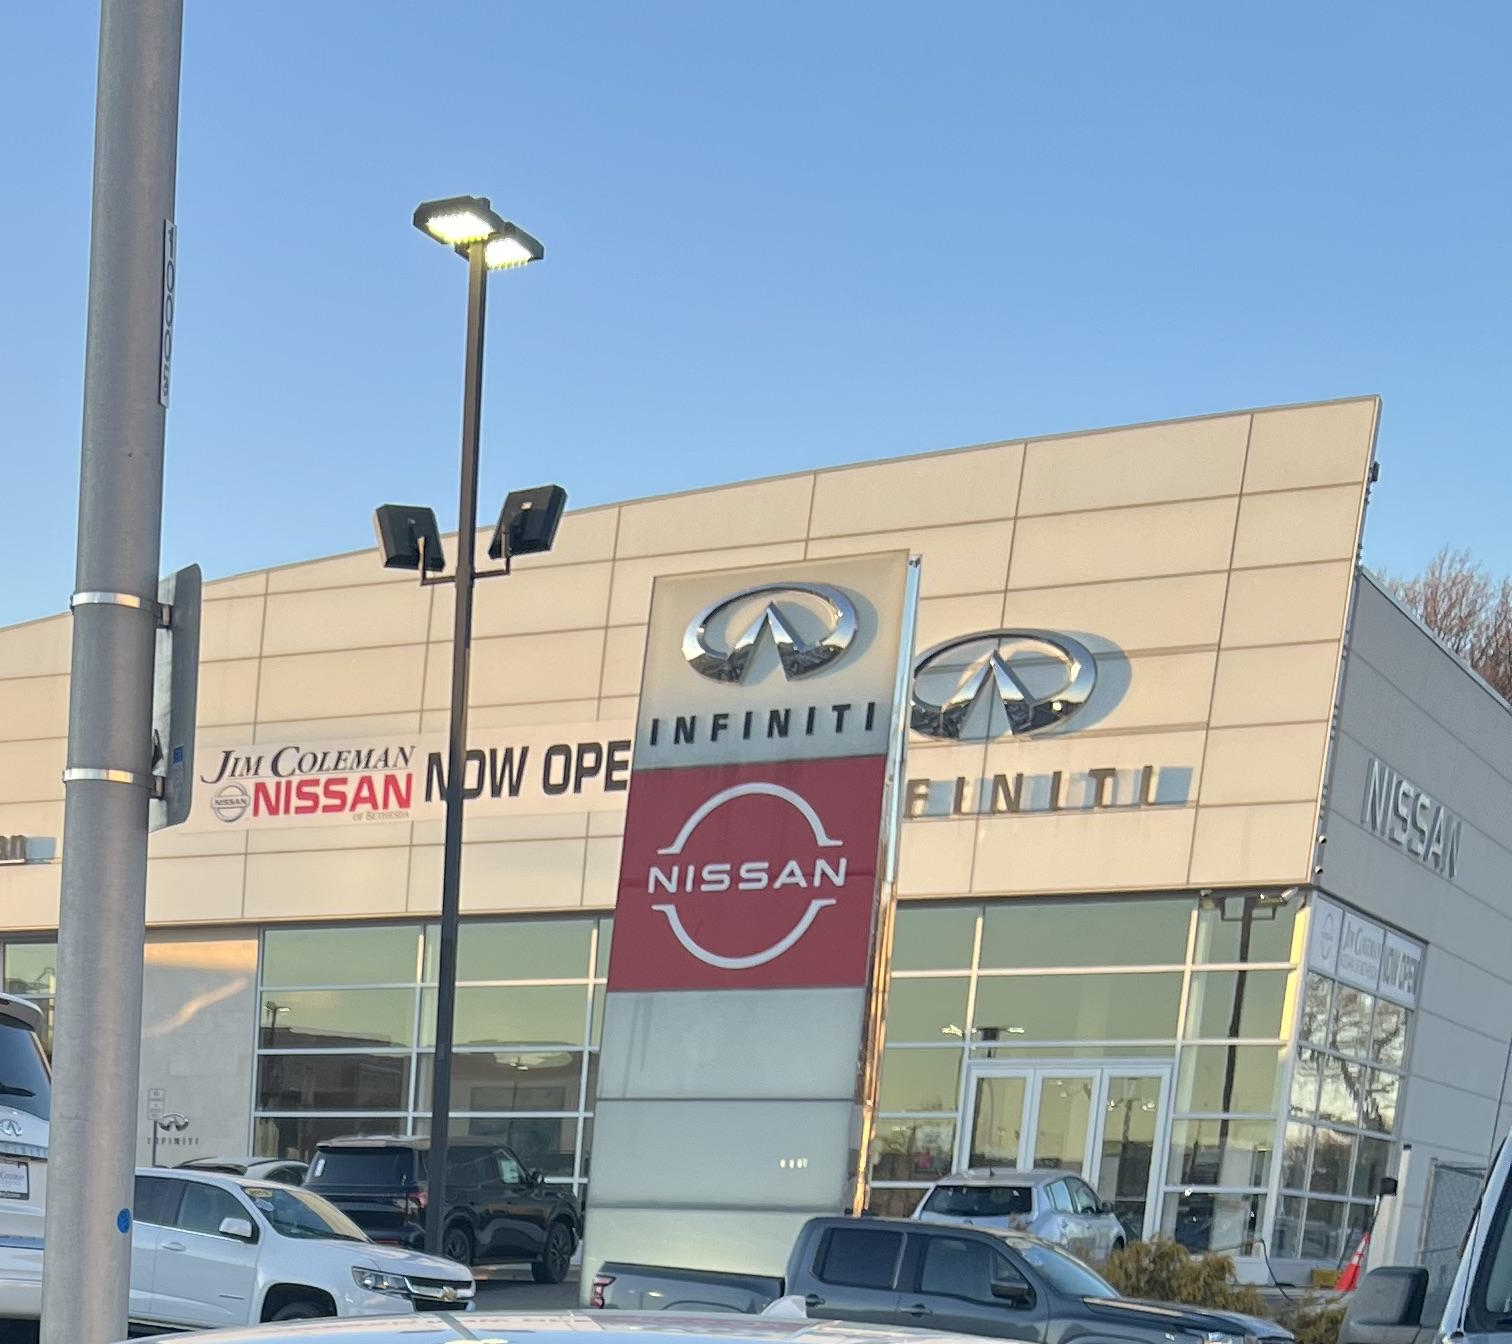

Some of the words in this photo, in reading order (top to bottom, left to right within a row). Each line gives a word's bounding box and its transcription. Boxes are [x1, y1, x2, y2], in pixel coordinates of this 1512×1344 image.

[649, 702, 876, 747] INFINITI
[200, 749, 264, 785] JIM
[271, 745, 416, 778] COLEMAN
[425, 746, 530, 802] NOW
[542, 740, 632, 796] OPE
[252, 773, 414, 818] NISSAN
[904, 765, 1153, 818] FINITI
[1361, 758, 1464, 880] NISSAN
[648, 858, 847, 894] NISSAN
